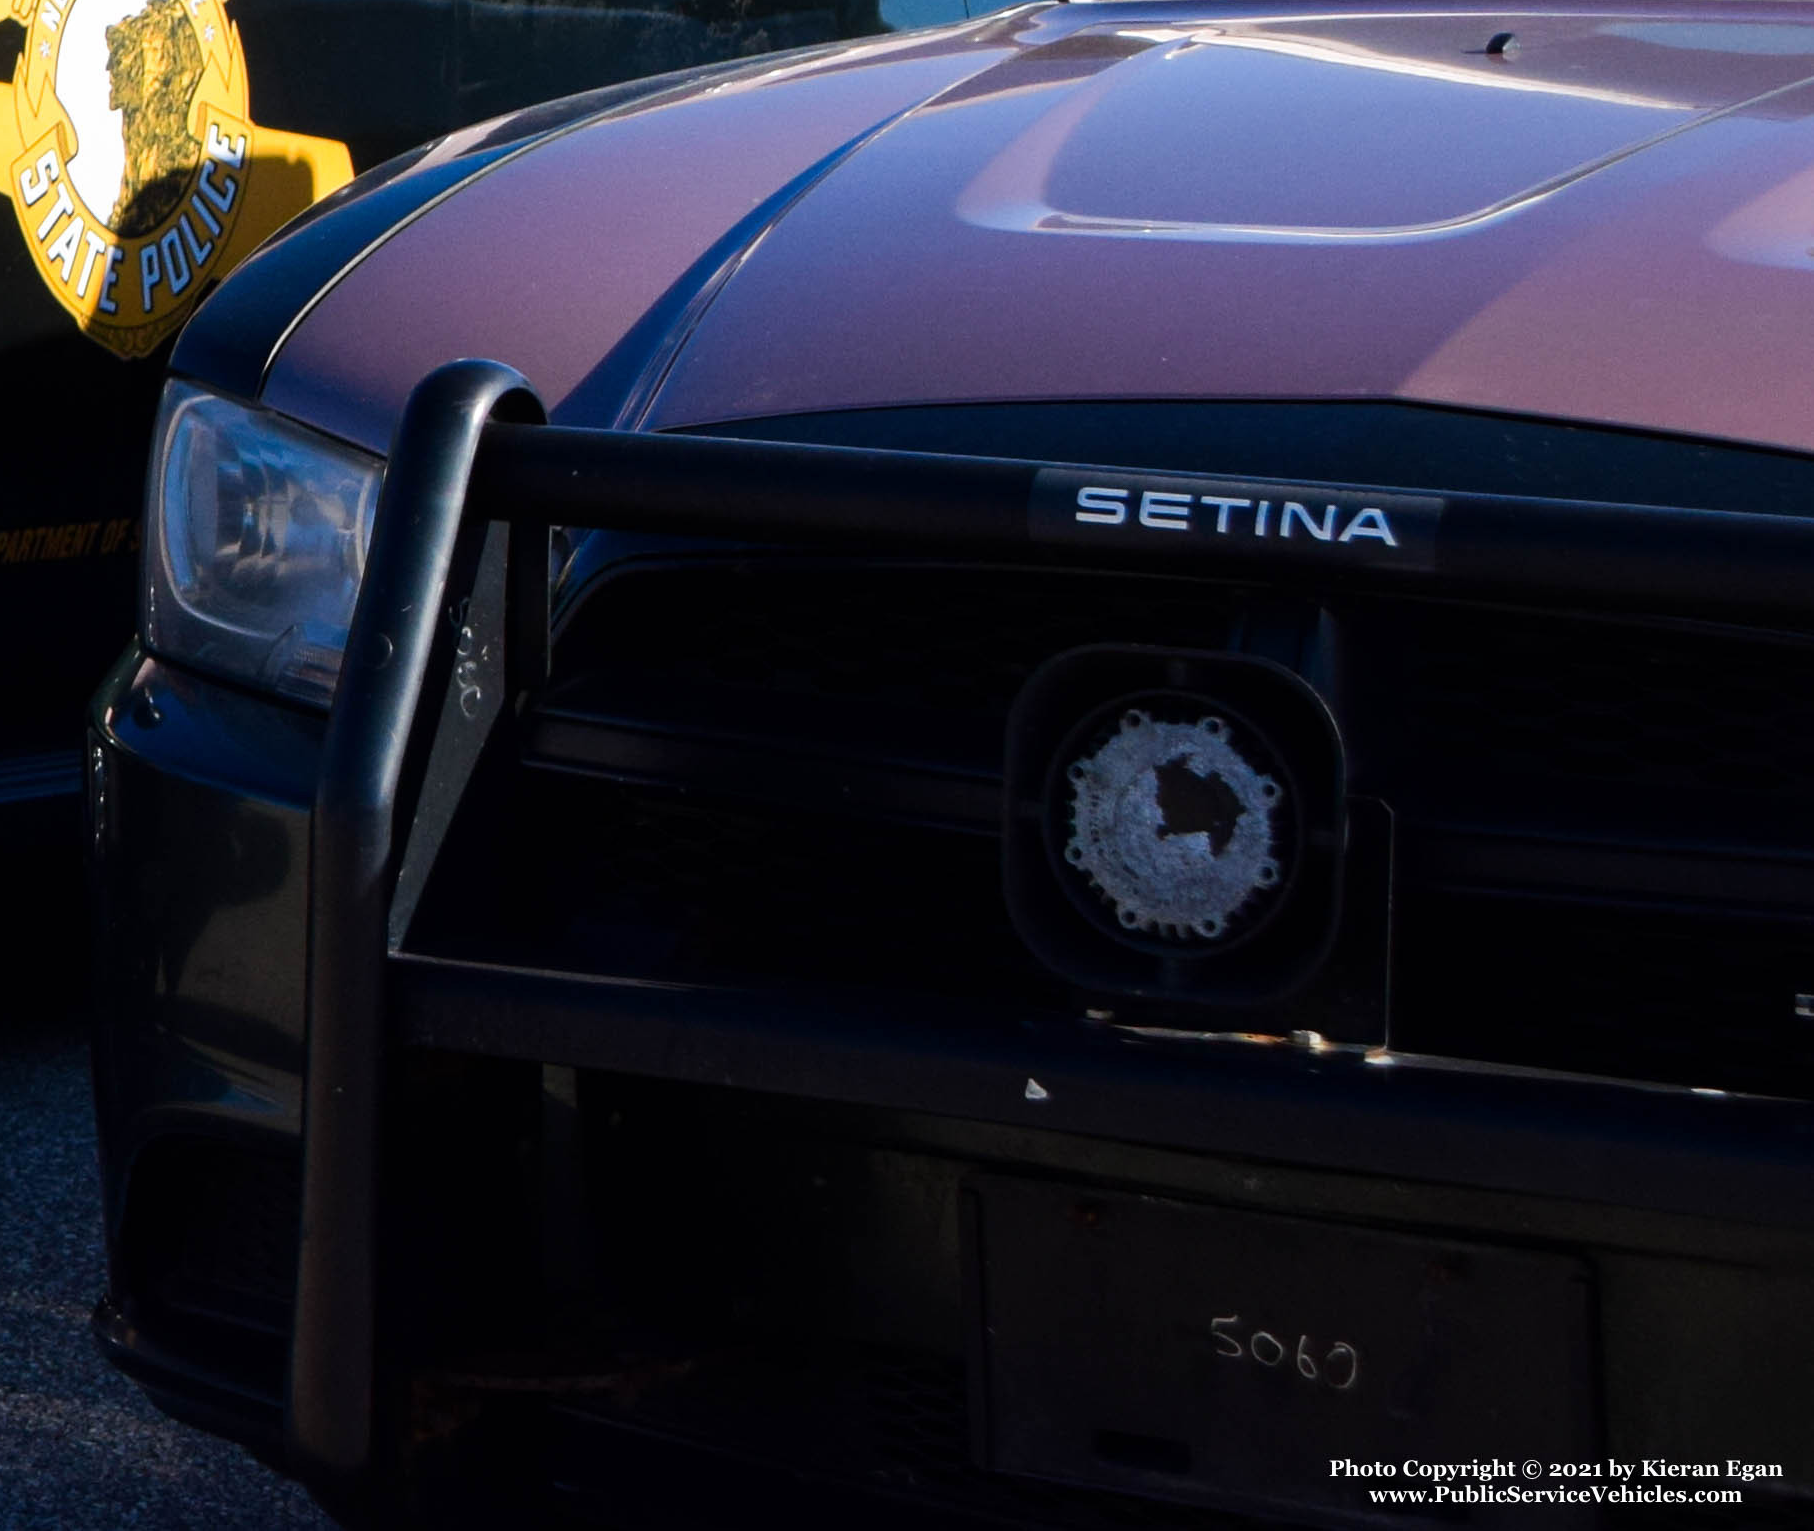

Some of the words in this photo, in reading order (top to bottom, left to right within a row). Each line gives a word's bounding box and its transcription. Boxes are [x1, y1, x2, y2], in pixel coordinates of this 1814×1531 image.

[19, 149, 122, 314] STATE
[139, 122, 247, 313] POLICE
[101, 517, 132, 555] OF
[1075, 486, 1400, 547] SETINA
